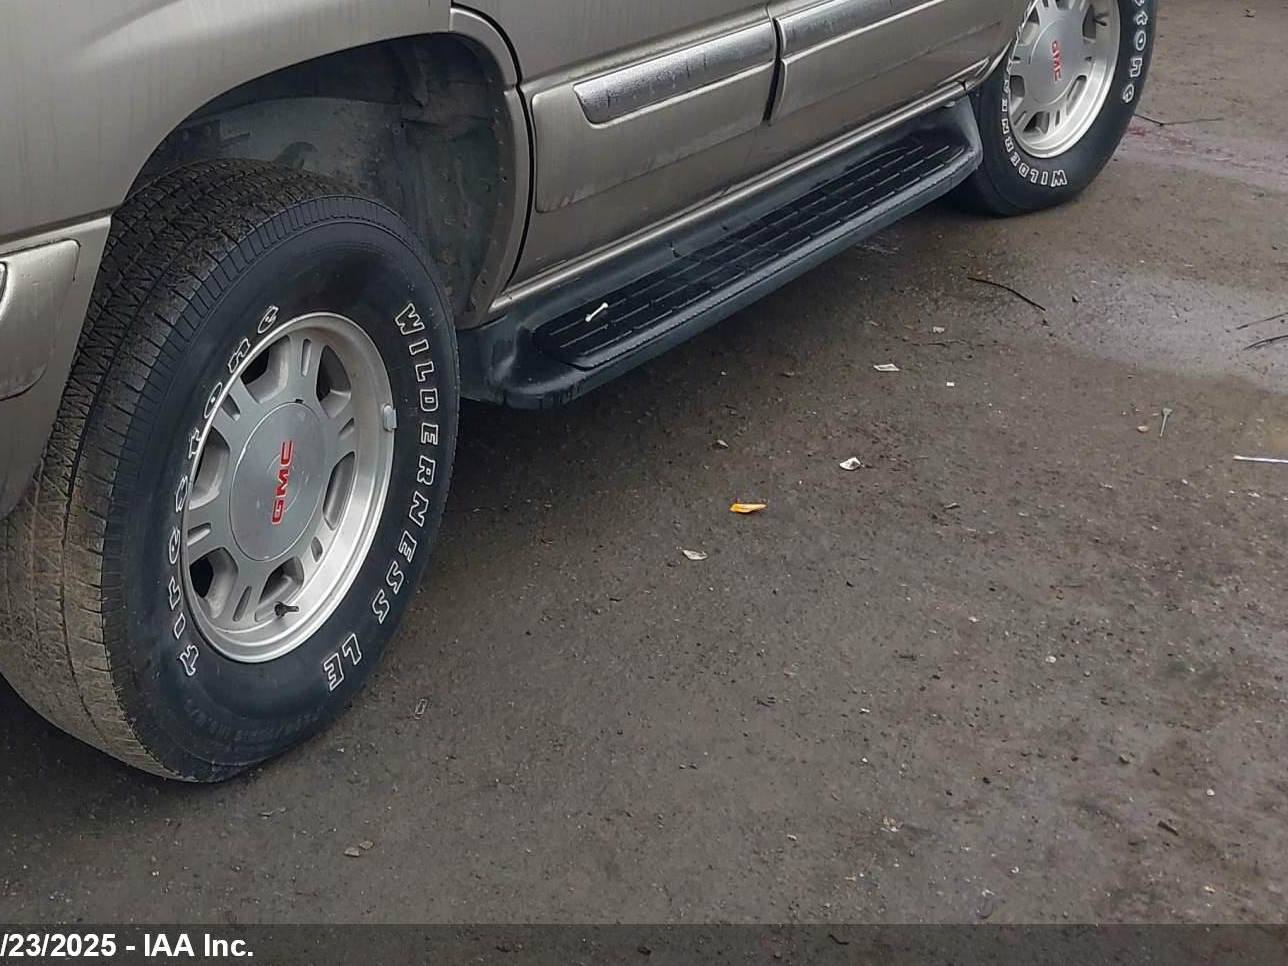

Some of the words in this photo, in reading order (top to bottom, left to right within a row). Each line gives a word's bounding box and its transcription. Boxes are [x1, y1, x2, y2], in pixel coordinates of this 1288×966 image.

[1051, 40, 1062, 83] GMC
[271, 440, 294, 526] GMC
[371, 302, 440, 625] WILDERNESS
[323, 632, 362, 691] LE
